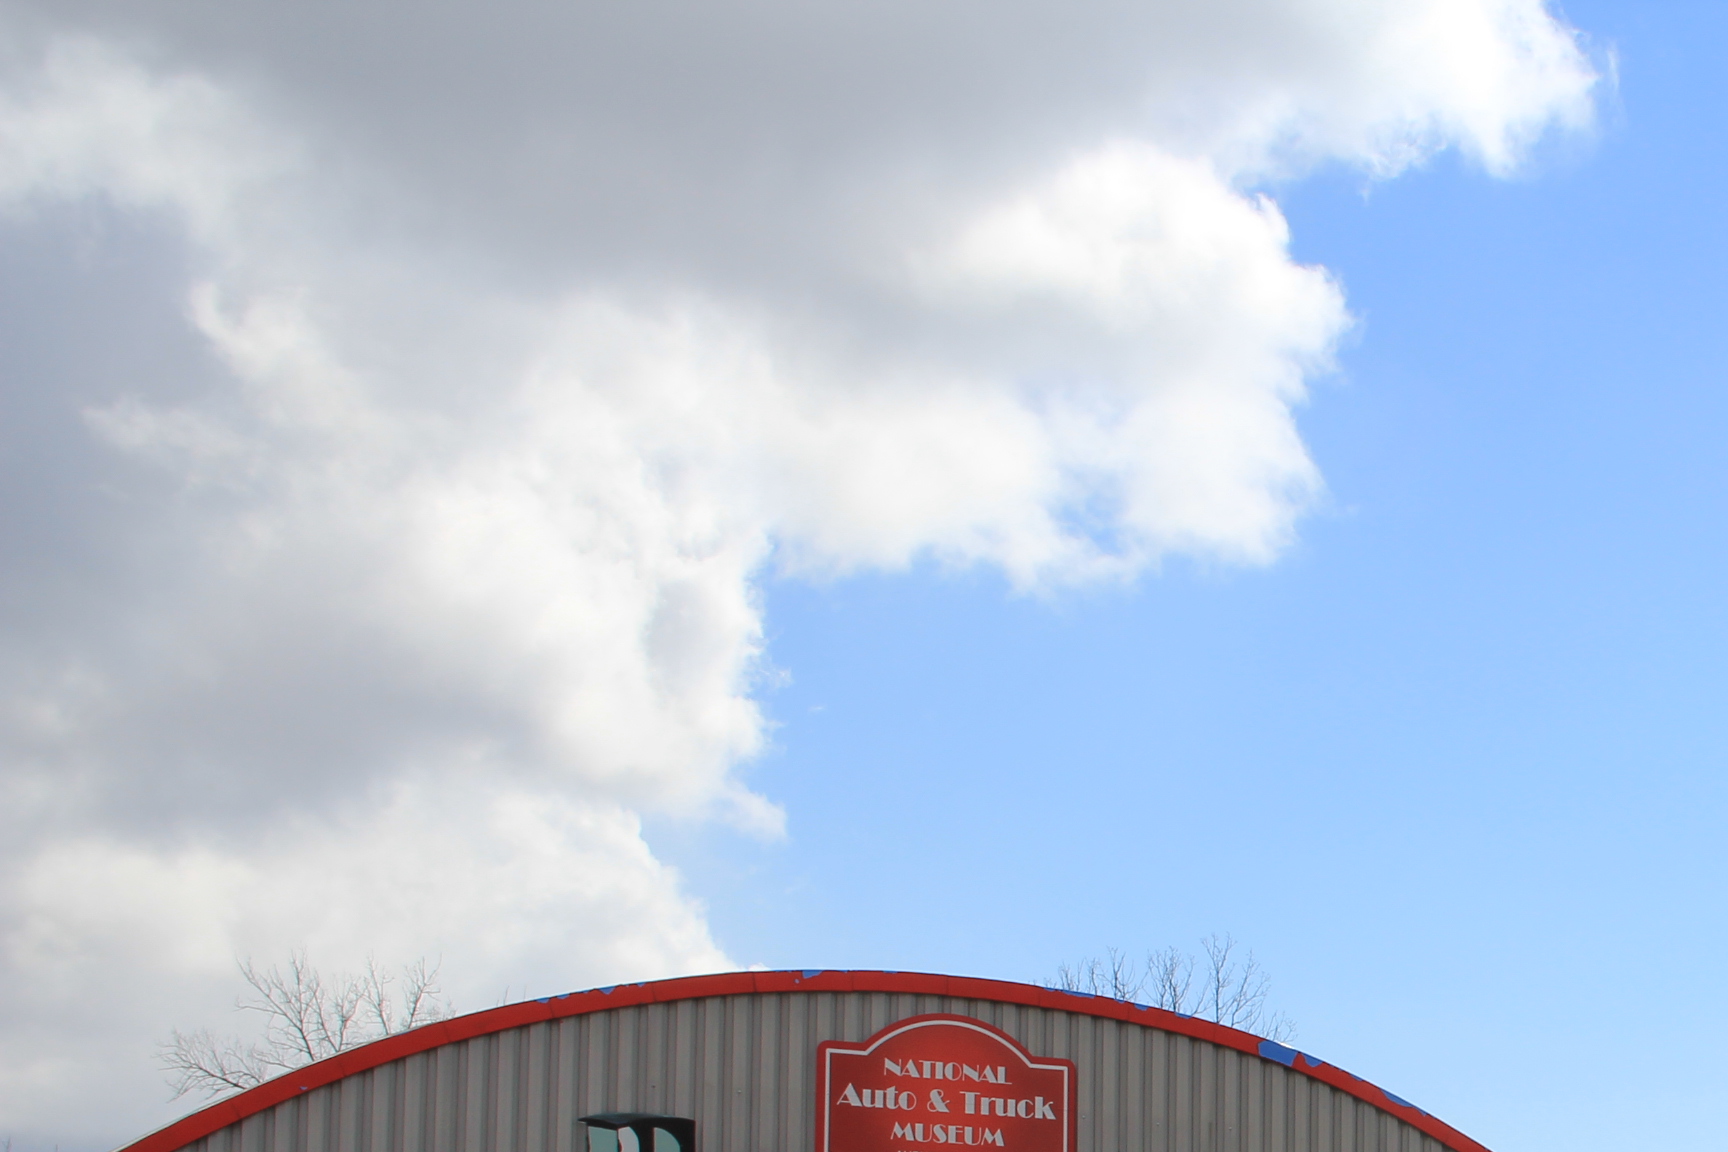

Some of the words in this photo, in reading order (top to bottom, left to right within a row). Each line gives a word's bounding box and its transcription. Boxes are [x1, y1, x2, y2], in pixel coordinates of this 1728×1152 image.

[883, 1057, 1012, 1085] NATIONAL
[836, 1083, 917, 1111] Auto
[926, 1089, 950, 1113] &
[959, 1091, 1056, 1120] Truck
[890, 1121, 1005, 1147] MUSEUM
